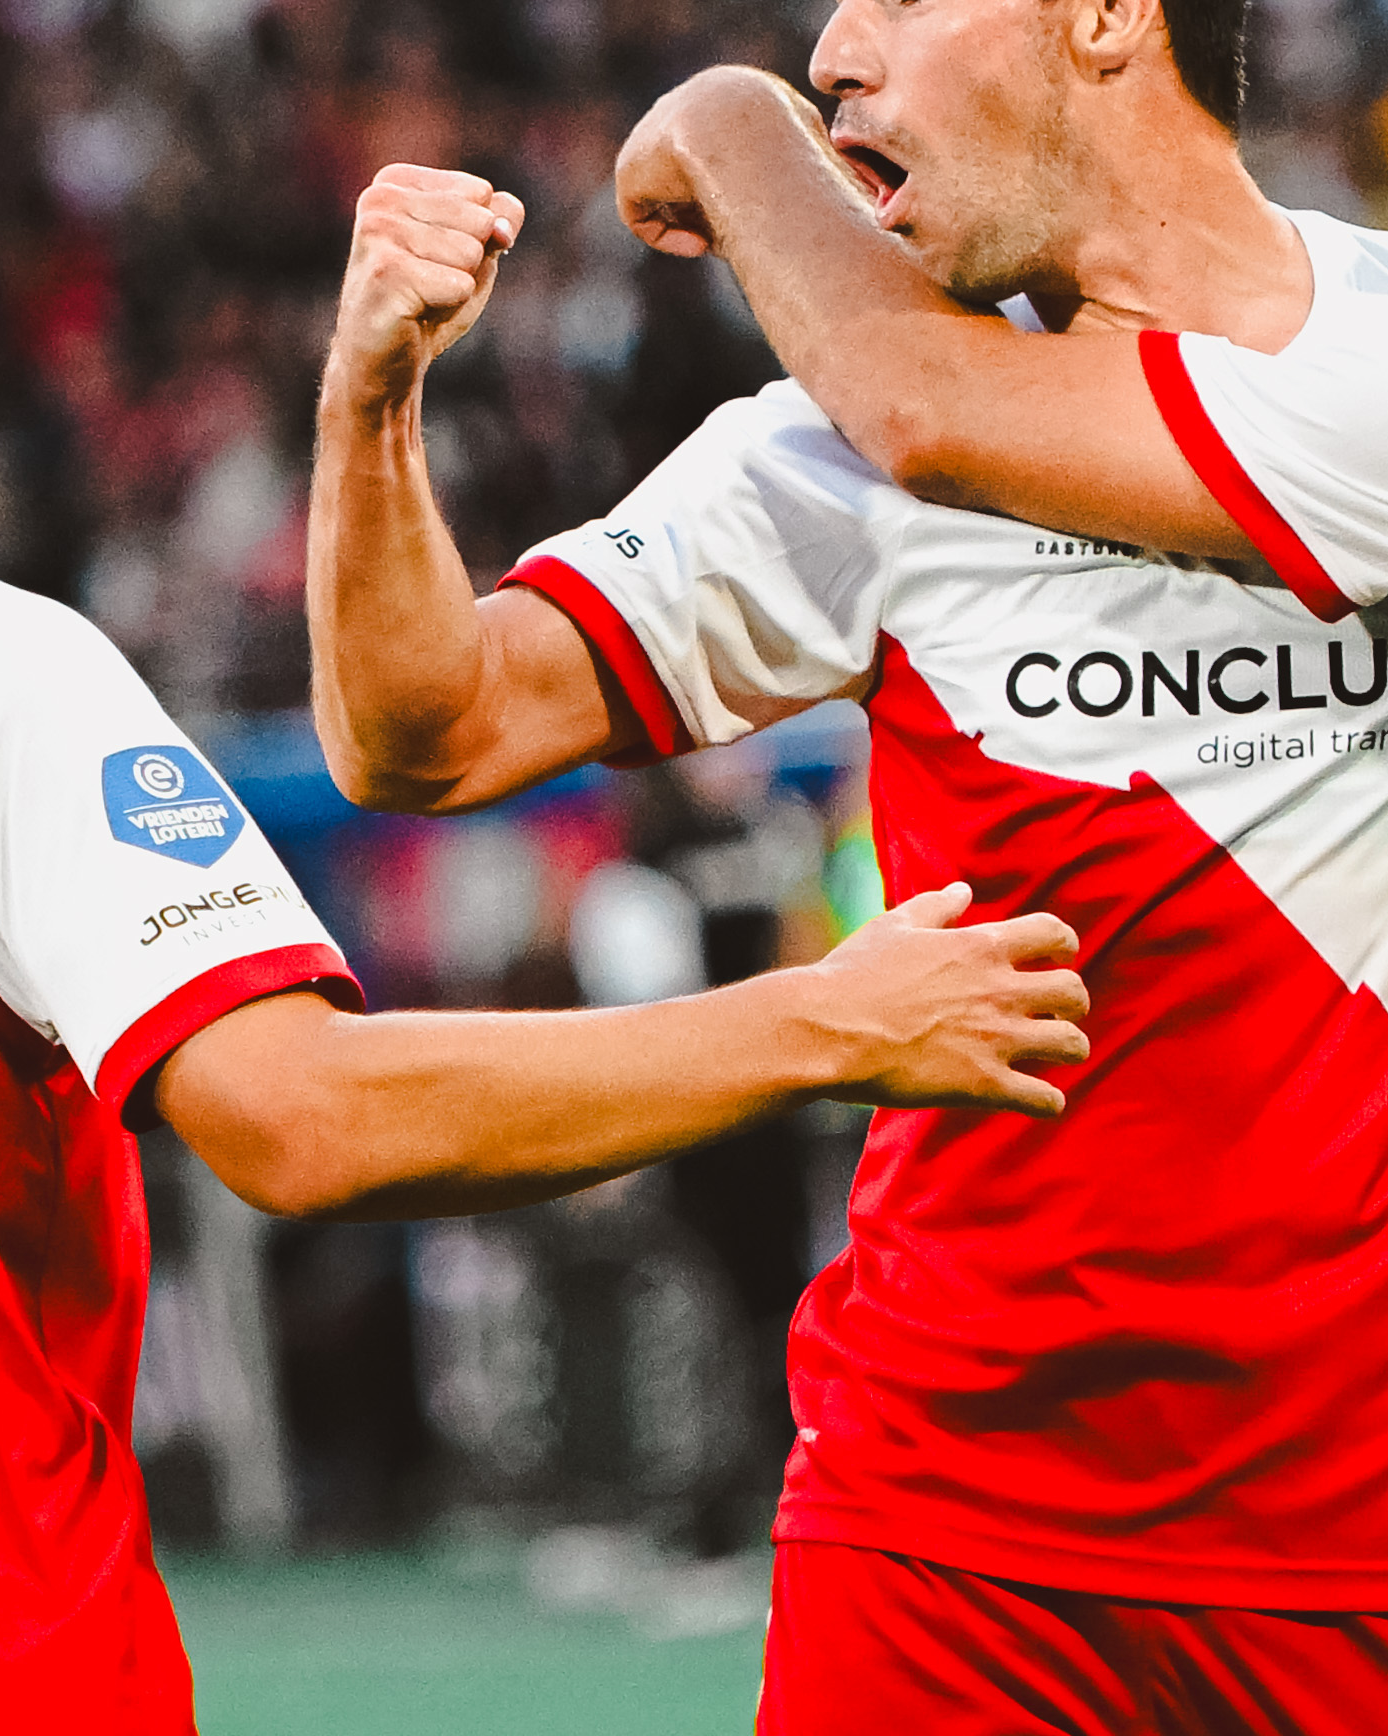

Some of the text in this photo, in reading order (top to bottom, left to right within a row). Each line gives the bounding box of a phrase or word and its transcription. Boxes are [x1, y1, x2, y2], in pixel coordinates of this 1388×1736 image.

[1197, 729, 1315, 768] digital
[128, 804, 229, 829] VRIENDEN
[149, 820, 225, 845] LOTERIJ
